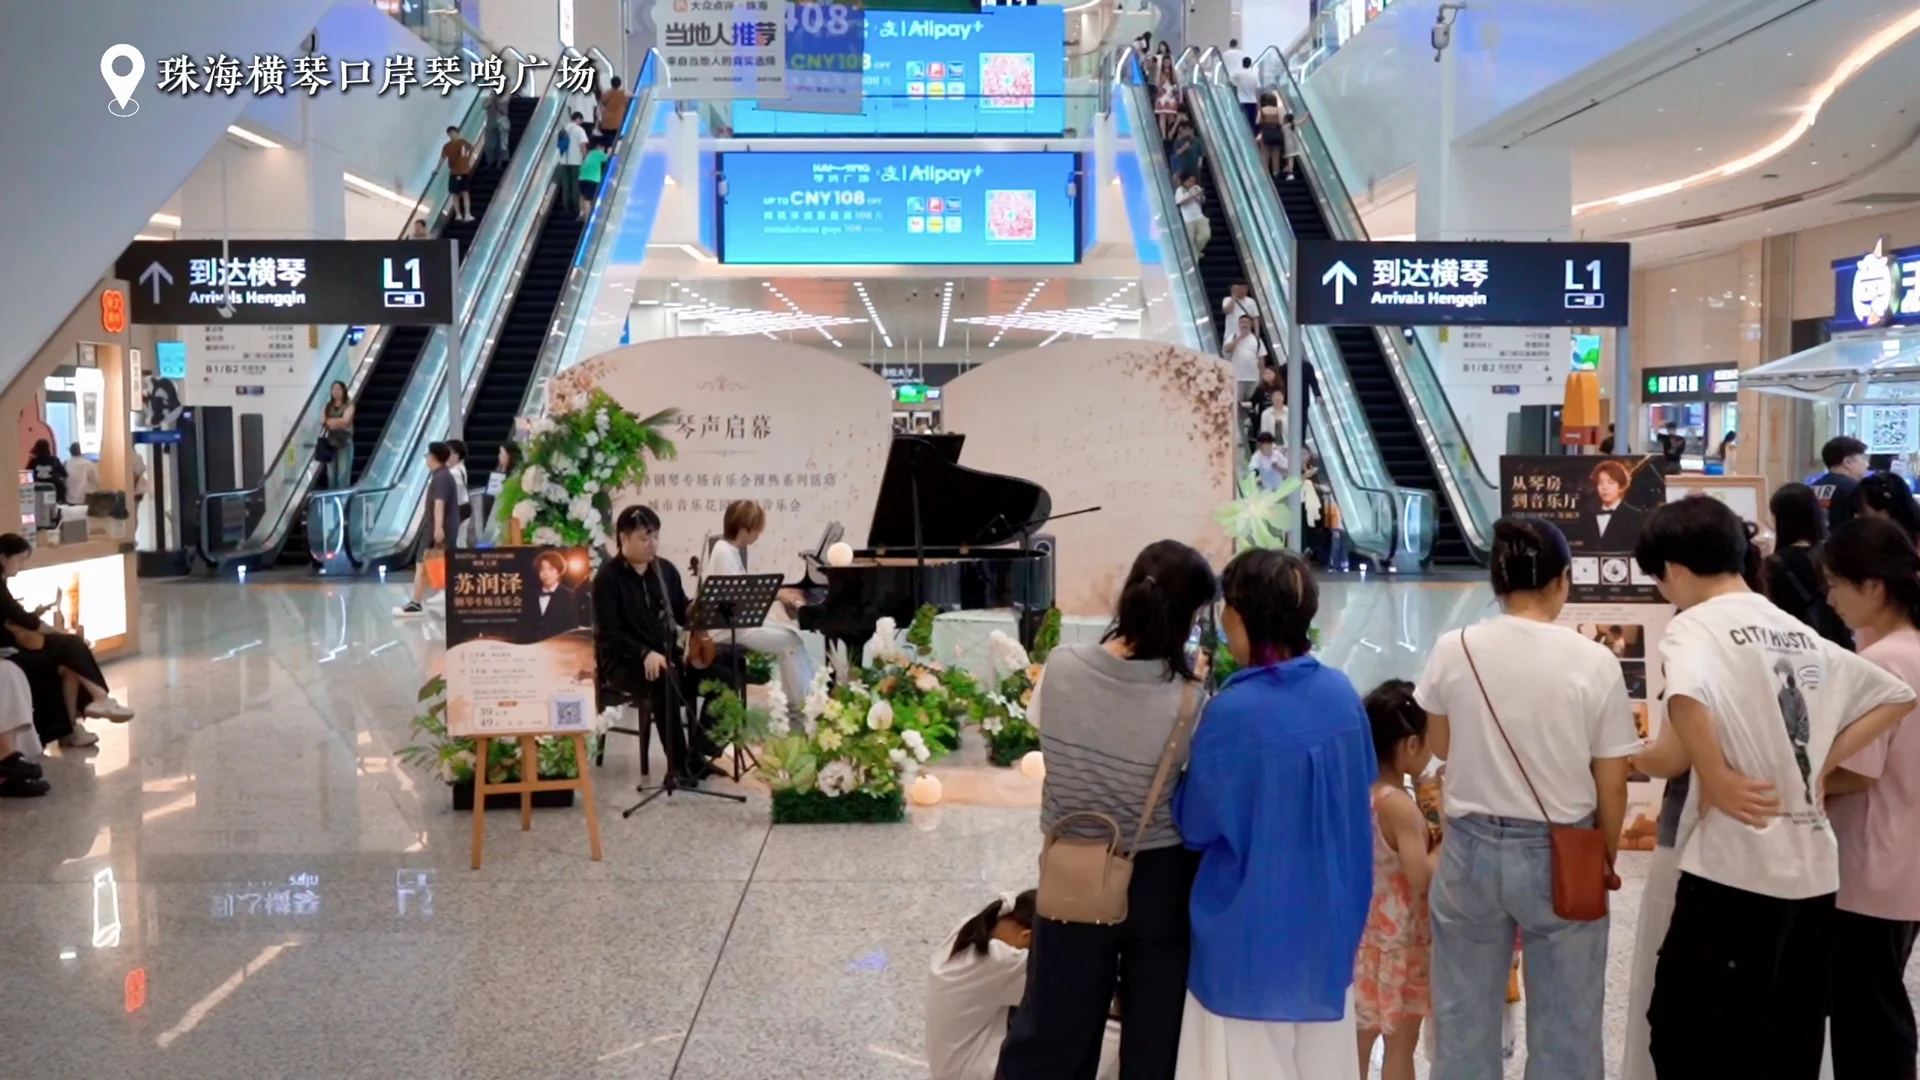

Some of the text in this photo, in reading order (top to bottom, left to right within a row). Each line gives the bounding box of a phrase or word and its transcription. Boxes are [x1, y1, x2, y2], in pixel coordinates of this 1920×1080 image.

[665, 22, 777, 47] 当地人推荐
[908, 19, 985, 41] Alipay+
[908, 164, 984, 184] Alipay+
[189, 258, 306, 287] 到达横琴
[383, 258, 420, 289] L1
[1372, 259, 1489, 288] 到达横琴
[1565, 259, 1601, 290] L1
[246, 291, 306, 307] Hengqin
[1371, 291, 1487, 308] Arrivals Hengqin
[674, 413, 773, 441] 琴声启幕
[1511, 475, 1562, 492] 从琴房
[1512, 493, 1580, 509] 到音乐厅
[453, 572, 523, 595] 苏润泽
